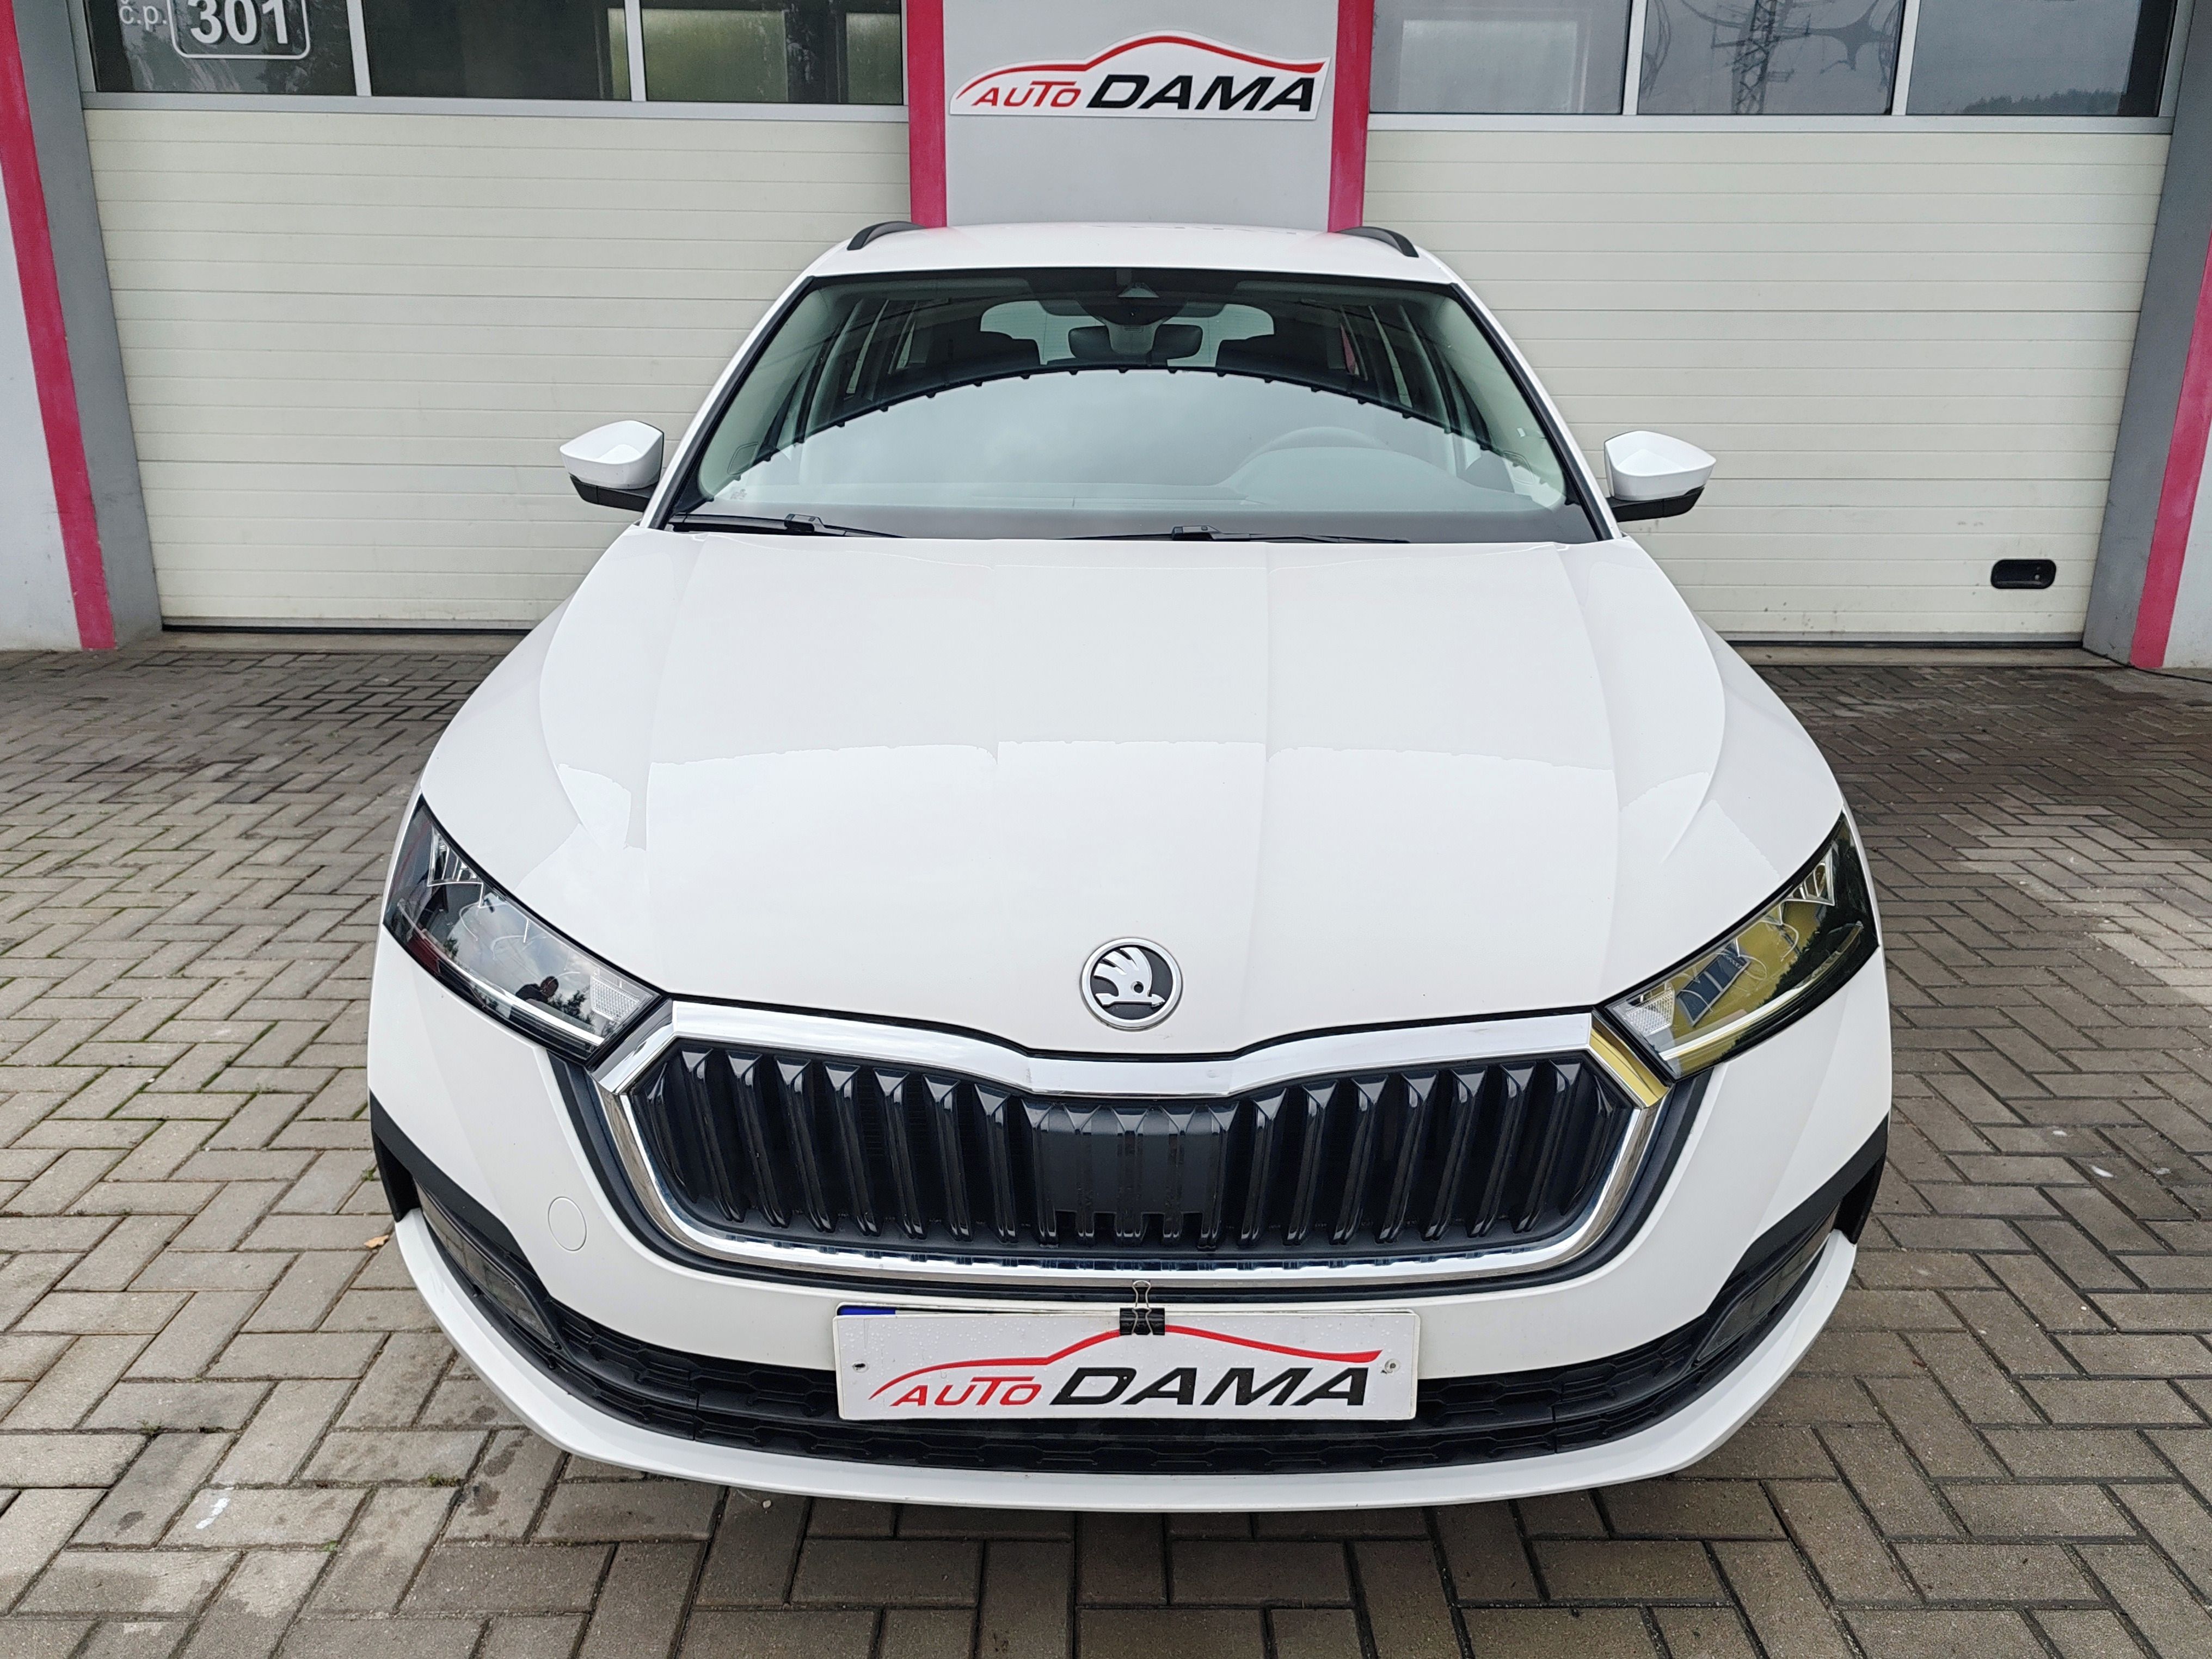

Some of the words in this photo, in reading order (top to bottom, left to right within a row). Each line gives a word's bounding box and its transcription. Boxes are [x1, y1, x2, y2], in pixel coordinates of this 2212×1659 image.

[188, 0, 288, 44] 301
[1086, 74, 1314, 112] DAMA
[1048, 1367, 1369, 1406] DAMA
